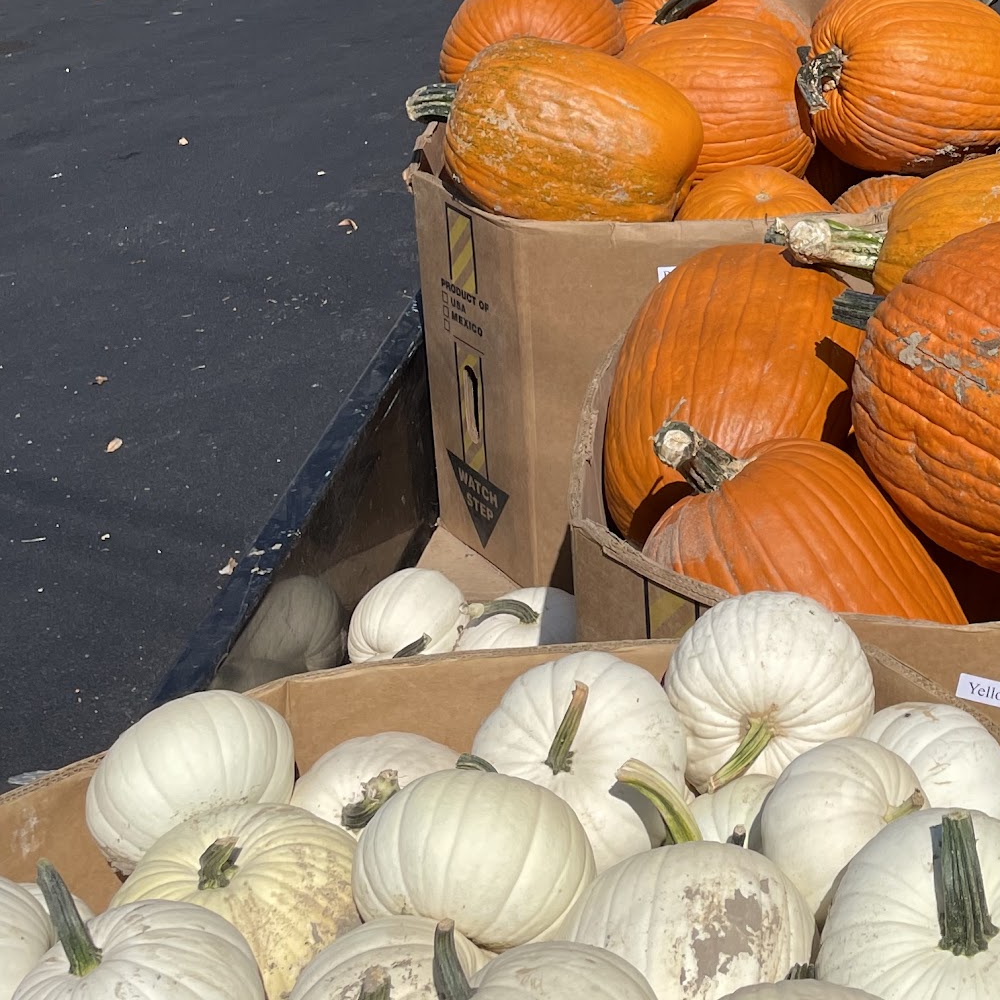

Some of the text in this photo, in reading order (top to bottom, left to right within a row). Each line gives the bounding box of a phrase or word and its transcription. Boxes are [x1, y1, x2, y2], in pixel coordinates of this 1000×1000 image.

[441, 278, 489, 312] PRODUCT OF
[451, 297, 466, 314] USA
[452, 311, 482, 336] MEXICO
[458, 467, 498, 508] WATCH
[466, 492, 494, 520] STEP
